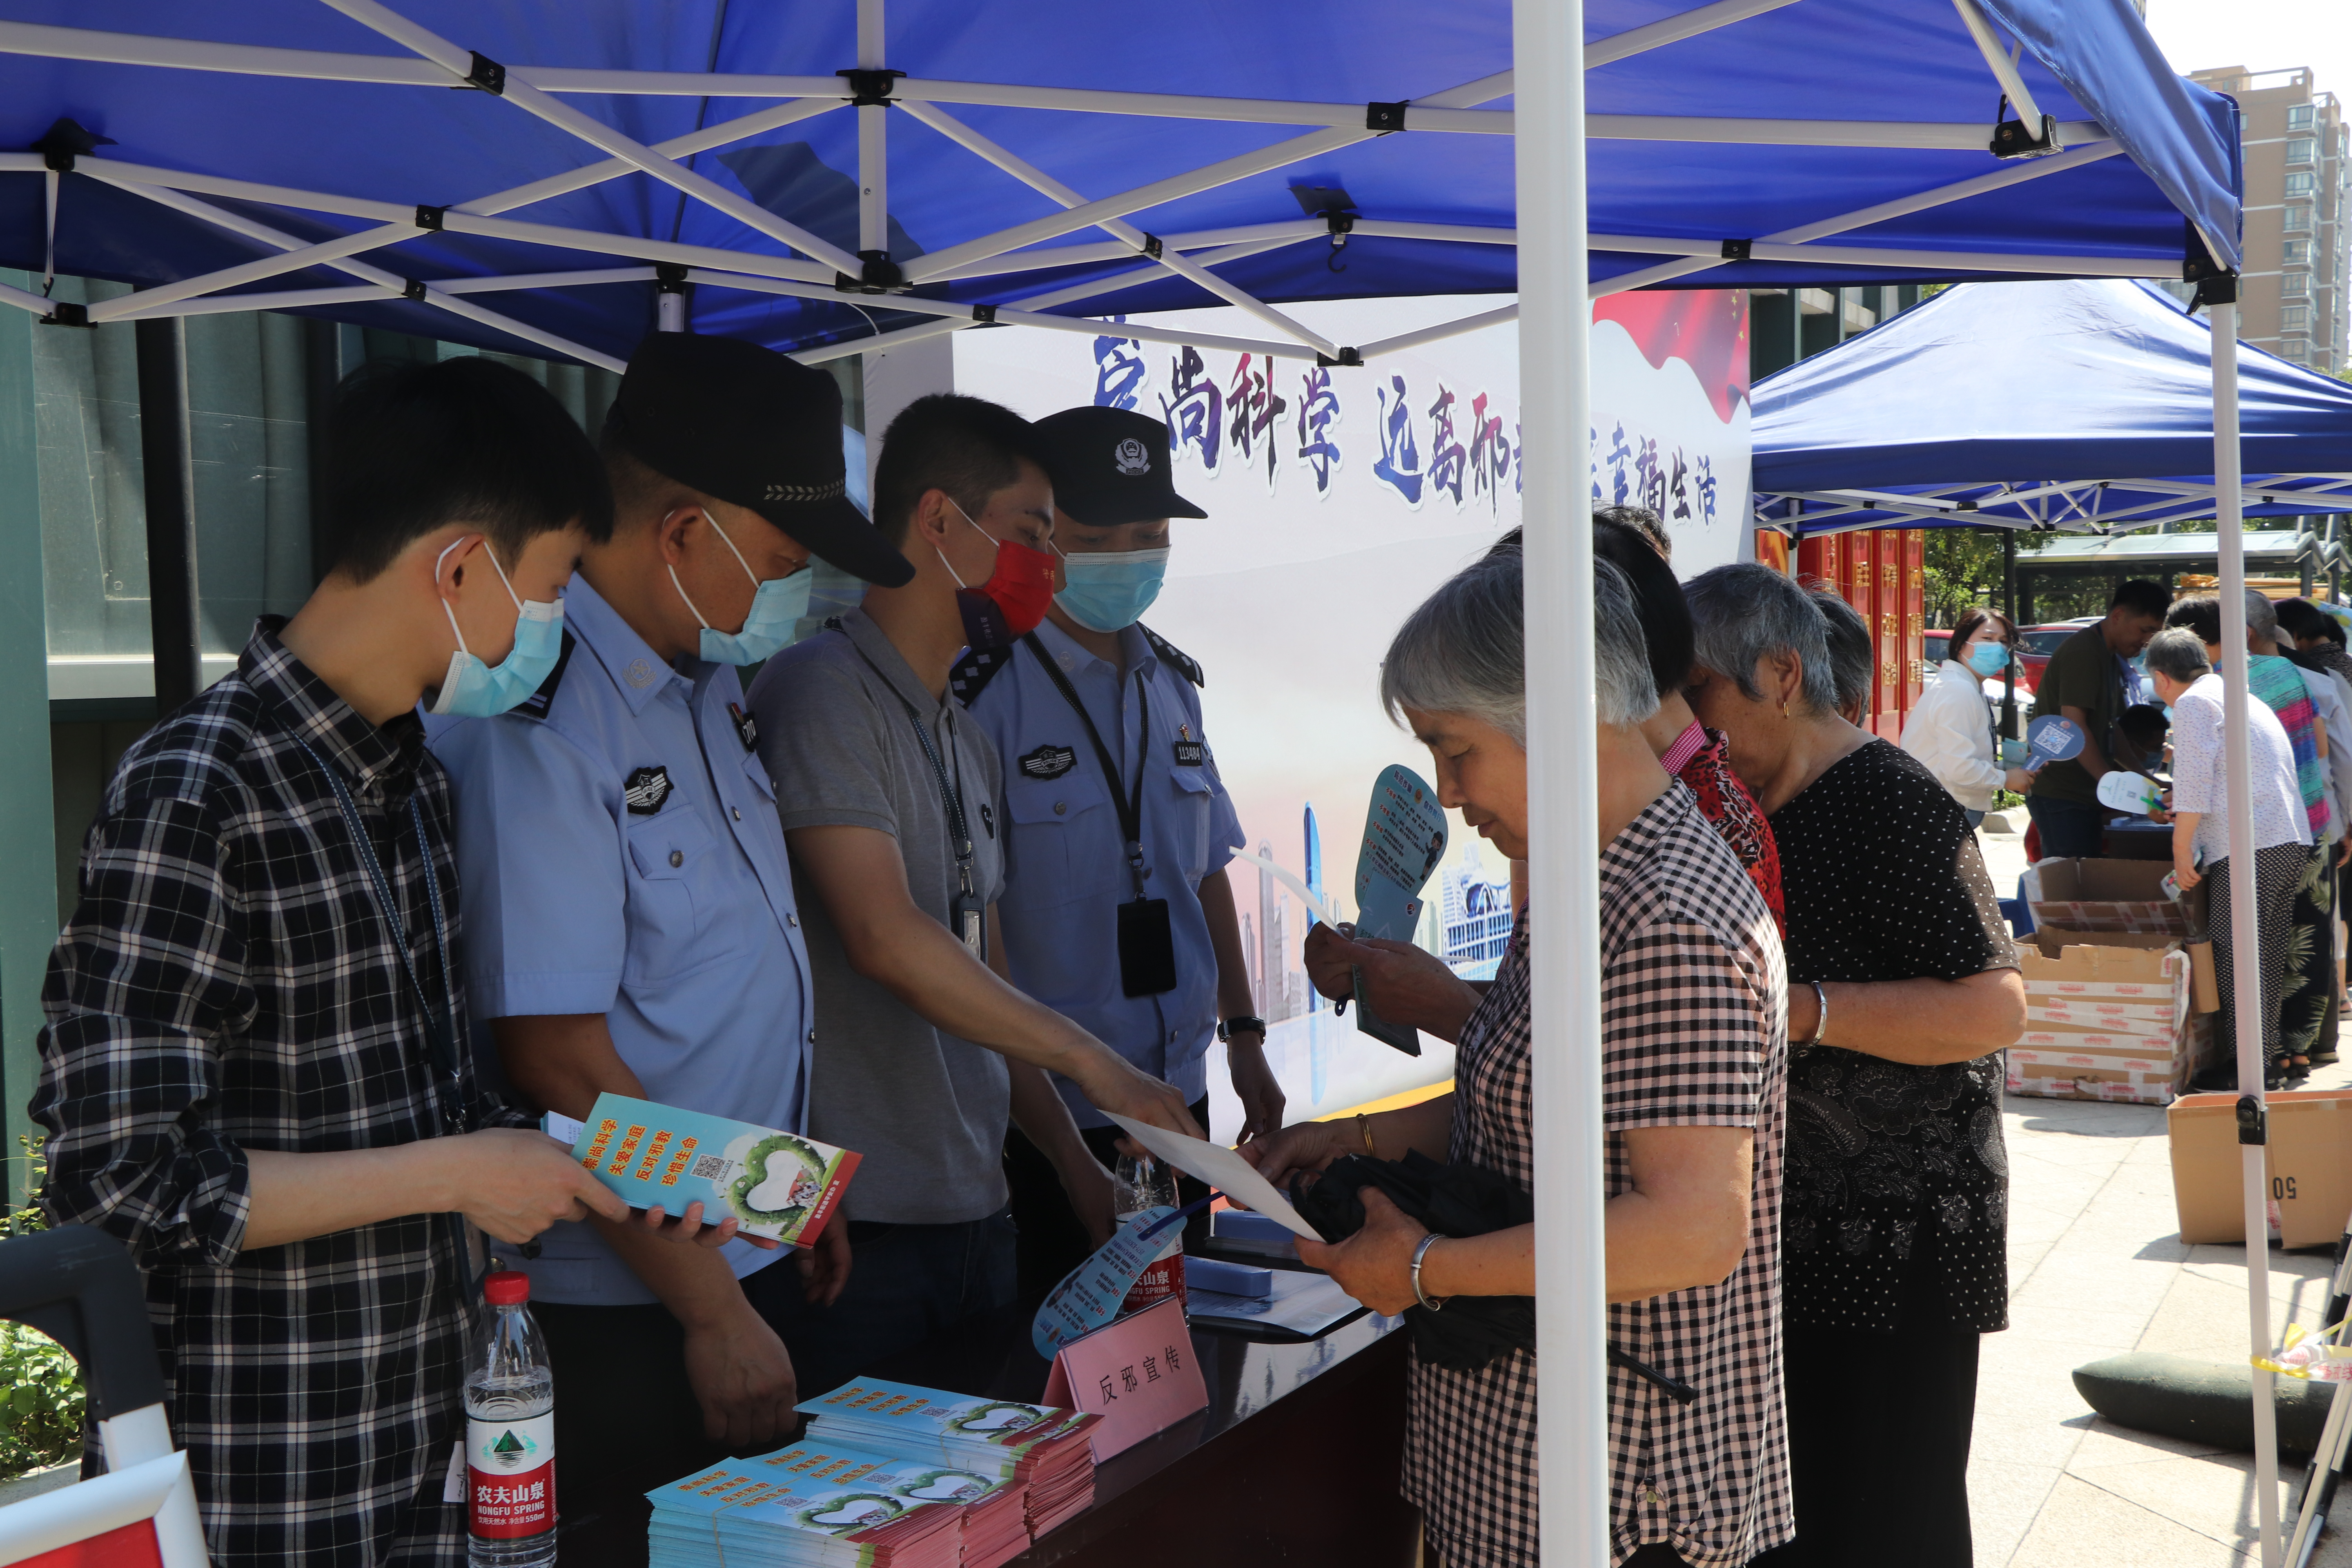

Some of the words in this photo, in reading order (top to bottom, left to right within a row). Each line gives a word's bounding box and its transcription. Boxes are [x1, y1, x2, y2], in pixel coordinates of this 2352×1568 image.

[1373, 375, 1523, 518] 远离邪
[1592, 420, 1716, 525] 幸福生活
[1178, 746, 1200, 760] 113484
[581, 1118, 618, 1170] 崇尚科学
[608, 1124, 647, 1176] 关爱家庭
[635, 1129, 673, 1181] 反对邪教
[661, 1136, 699, 1187] 珍惜生命
[2272, 1176, 2296, 1200] 50
[1137, 1270, 1170, 1286] 山泉
[1145, 1286, 1170, 1294] SPRING
[1099, 1346, 1181, 1406] 反邪宣传
[844, 1390, 888, 1408] 关爱家庭
[866, 1394, 909, 1412] 反对邪教
[887, 1398, 931, 1416] 珍惜生命
[763, 1450, 808, 1466] 崇尚科学
[786, 1454, 832, 1472] 关爱家庭
[808, 1459, 855, 1479] 反对邪教
[831, 1463, 876, 1484] 珍惜生命
[677, 1470, 730, 1491] 崇尚科学
[698, 1475, 753, 1497] 关爱家庭
[477, 1481, 545, 1504] 农夫山泉
[719, 1482, 773, 1503] 反对邪教
[739, 1487, 793, 1507] 珍惜生命
[477, 1504, 510, 1516] NONGFU
[514, 1500, 545, 1515] SPRING
[478, 1516, 507, 1526] 饮用天然水
[525, 1512, 545, 1523] 550ml
